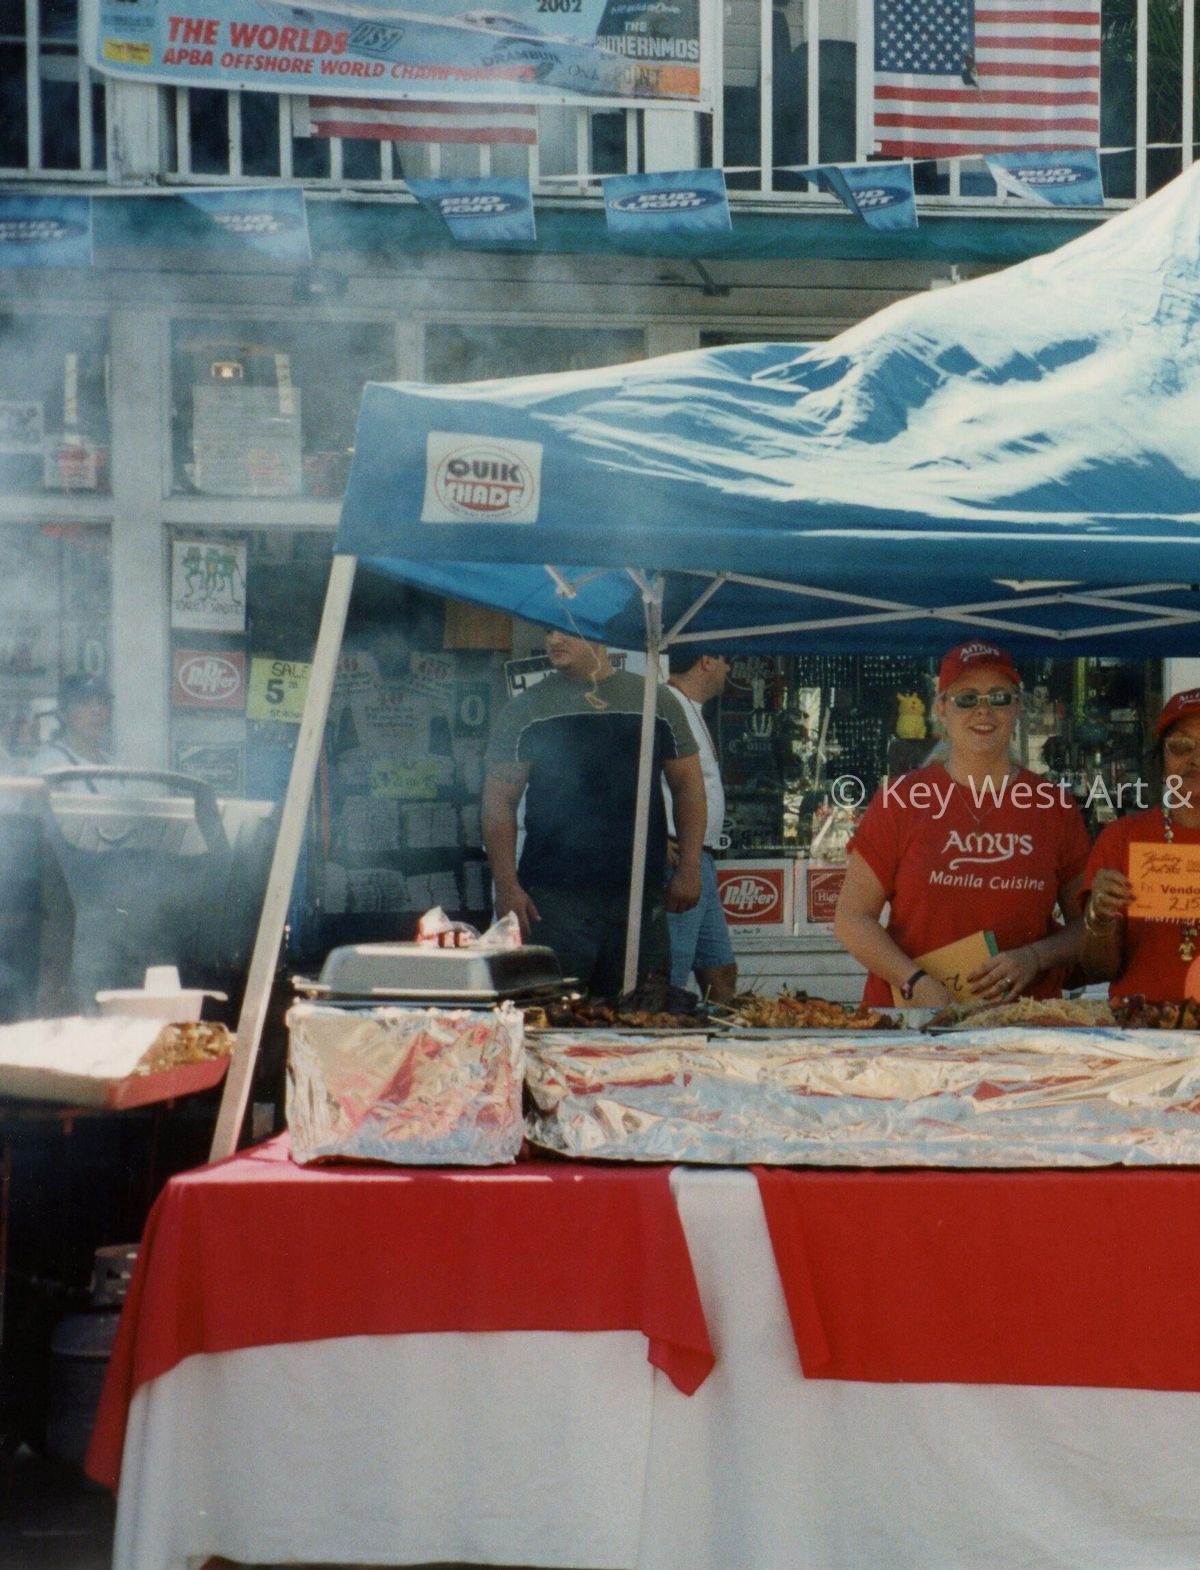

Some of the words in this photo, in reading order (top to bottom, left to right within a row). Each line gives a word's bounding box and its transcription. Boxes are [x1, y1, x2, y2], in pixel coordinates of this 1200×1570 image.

[168, 16, 220, 46] THE
[229, 21, 348, 55] WORLDS
[162, 47, 213, 67] APBA
[220, 53, 315, 75] OFFSHORE
[320, 59, 385, 79] WORLD
[1018, 167, 1073, 176] BUD
[1019, 174, 1081, 183] IGHT
[638, 190, 698, 202] BUD
[852, 188, 886, 198] UD
[439, 195, 501, 205] BUD
[627, 198, 707, 211] LIGHT
[442, 203, 511, 213] IGHT
[447, 458, 521, 483] QUIK
[264, 678, 285, 705] 5
[929, 870, 983, 888] Manila
[989, 876, 1045, 891] Cuisine
